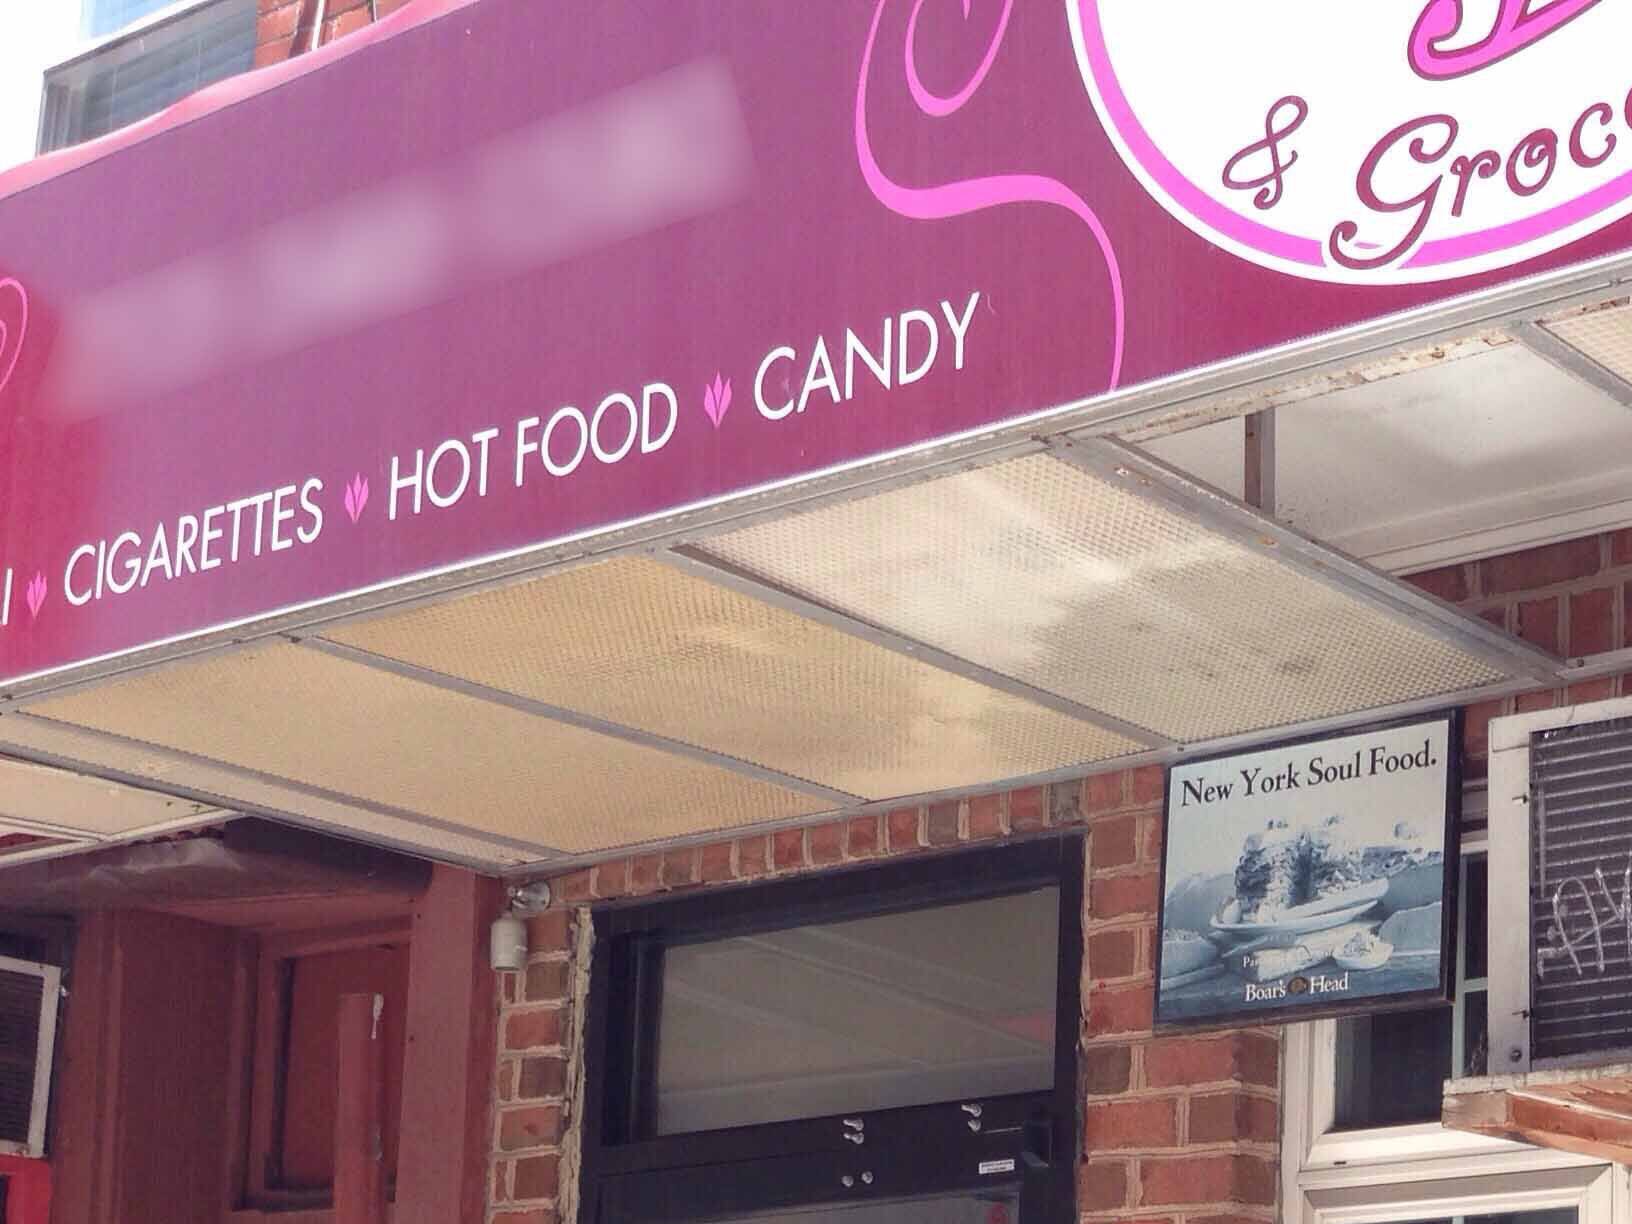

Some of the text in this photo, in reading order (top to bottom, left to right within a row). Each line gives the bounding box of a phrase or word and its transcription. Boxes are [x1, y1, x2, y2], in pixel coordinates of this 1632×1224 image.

[1222, 96, 1309, 210] &
[64, 478, 324, 606] CIGARETTES
[388, 428, 499, 521] HOT
[515, 382, 679, 488] FOOD
[754, 291, 981, 421] CANDY
[1181, 738, 1437, 807] New York Soul Food.
[1245, 971, 1348, 1002] Boar's Head
